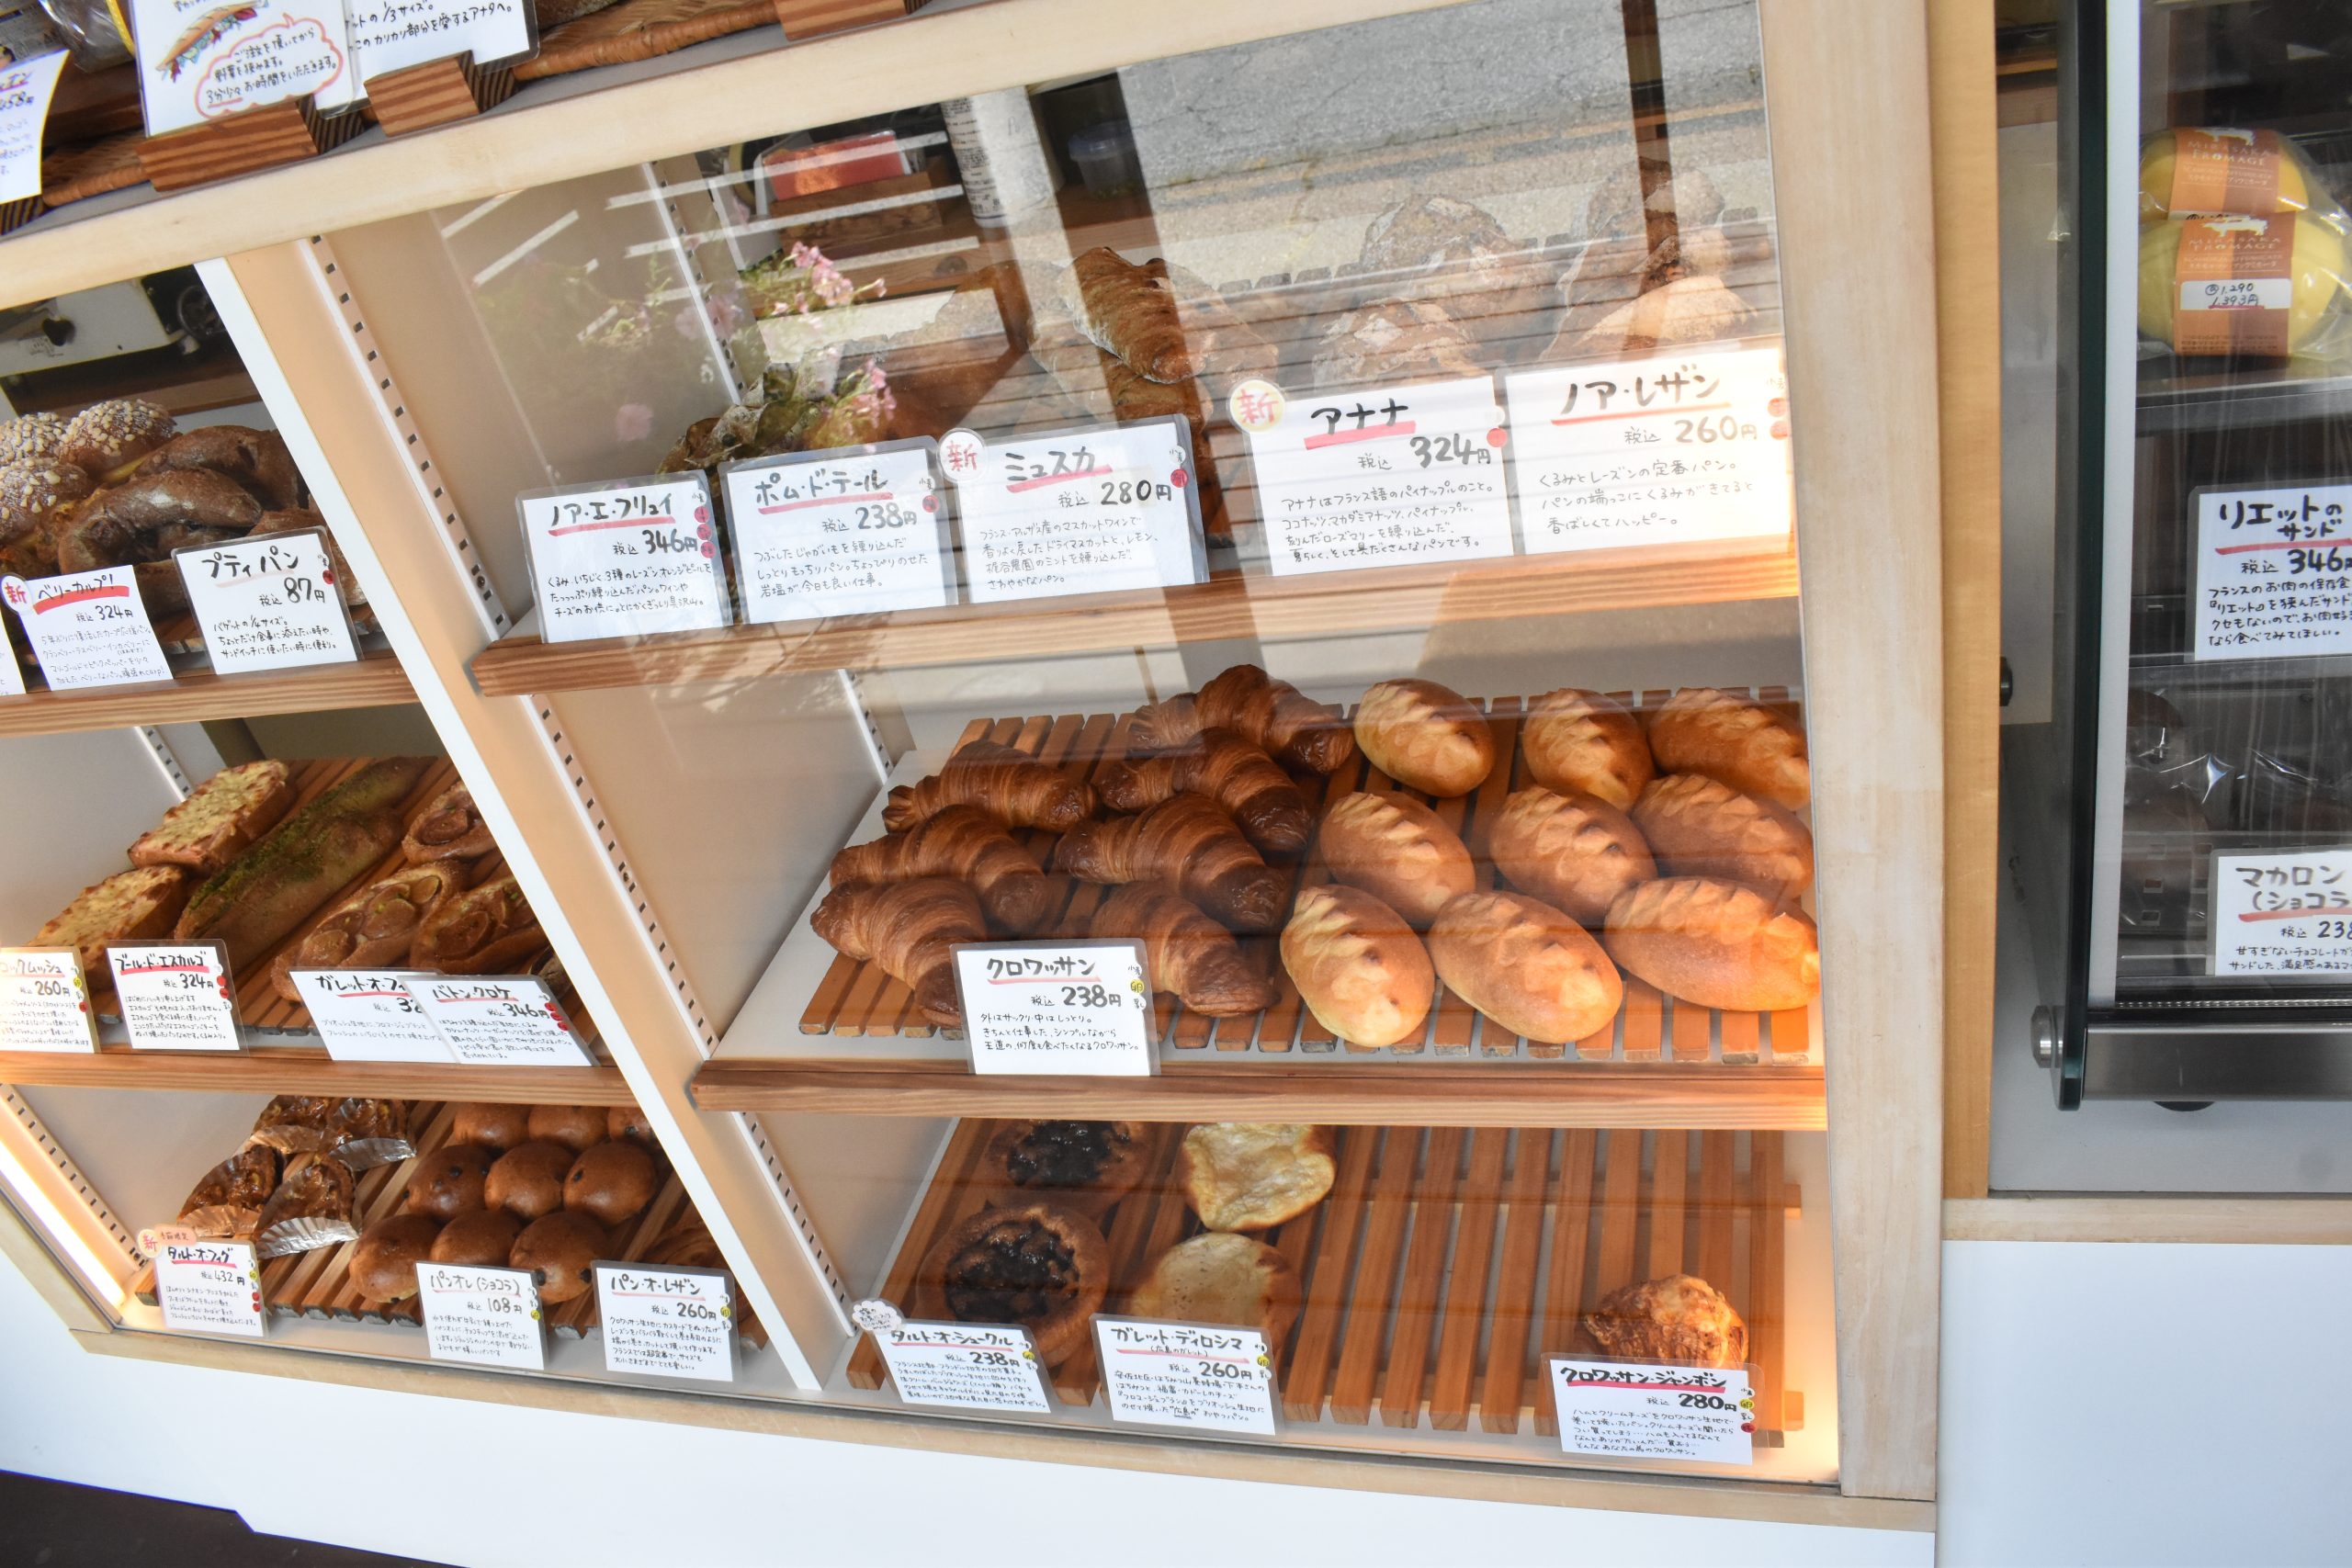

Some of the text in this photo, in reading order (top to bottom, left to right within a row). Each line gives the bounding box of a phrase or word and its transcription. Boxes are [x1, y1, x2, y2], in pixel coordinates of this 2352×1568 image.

[1560, 364, 1720, 414] ノア・レザン
[1236, 389, 1279, 424] 新
[1311, 398, 1408, 434] アナナ
[1624, 415, 1757, 444] 税込 260円
[946, 440, 978, 471] 新
[1358, 434, 1491, 470] 税込 324円
[1005, 446, 1096, 481] ミュスカ
[754, 468, 889, 506] ポム・ド・テール
[1057, 479, 1171, 507] 税込 280円
[551, 492, 673, 527] ノア・エ・フリュイ
[822, 502, 917, 533] 税込 238円
[2220, 494, 2343, 530] リエットの
[1547, 512, 1678, 535] 香ばしくてハッピー。
[2277, 519, 2342, 541] サンド
[613, 528, 698, 555] 税込 346円
[2241, 558, 2278, 574] 税込
[4, 582, 28, 604] 新
[259, 577, 325, 606] 税込 87円
[2209, 576, 2350, 598] フランスのお肉の保存食
[75, 605, 134, 623] 税込 324円
[2209, 629, 2340, 646] なら食べてみてほしい。
[2235, 865, 2346, 887] マカロン
[2280, 926, 2307, 939] 税込
[987, 956, 1096, 979] クロワッサン
[35, 980, 70, 997] 260円
[164, 974, 214, 989] 税込 324円
[1031, 984, 1122, 1009] 税込 238円
[503, 1002, 549, 1019] 346円
[611, 1273, 700, 1295] パン・オ・レザン
[467, 1297, 523, 1314] 税込 108円
[651, 1303, 717, 1321] 税込 260円
[1111, 1327, 1242, 1350] ガレット・ディロシマ
[969, 1351, 1020, 1368] 238円
[1169, 1361, 1252, 1381] 税込 260円
[1560, 1367, 1727, 1388] クロワッサン・ジャンボン
[1646, 1393, 1737, 1412] 税込 280円
